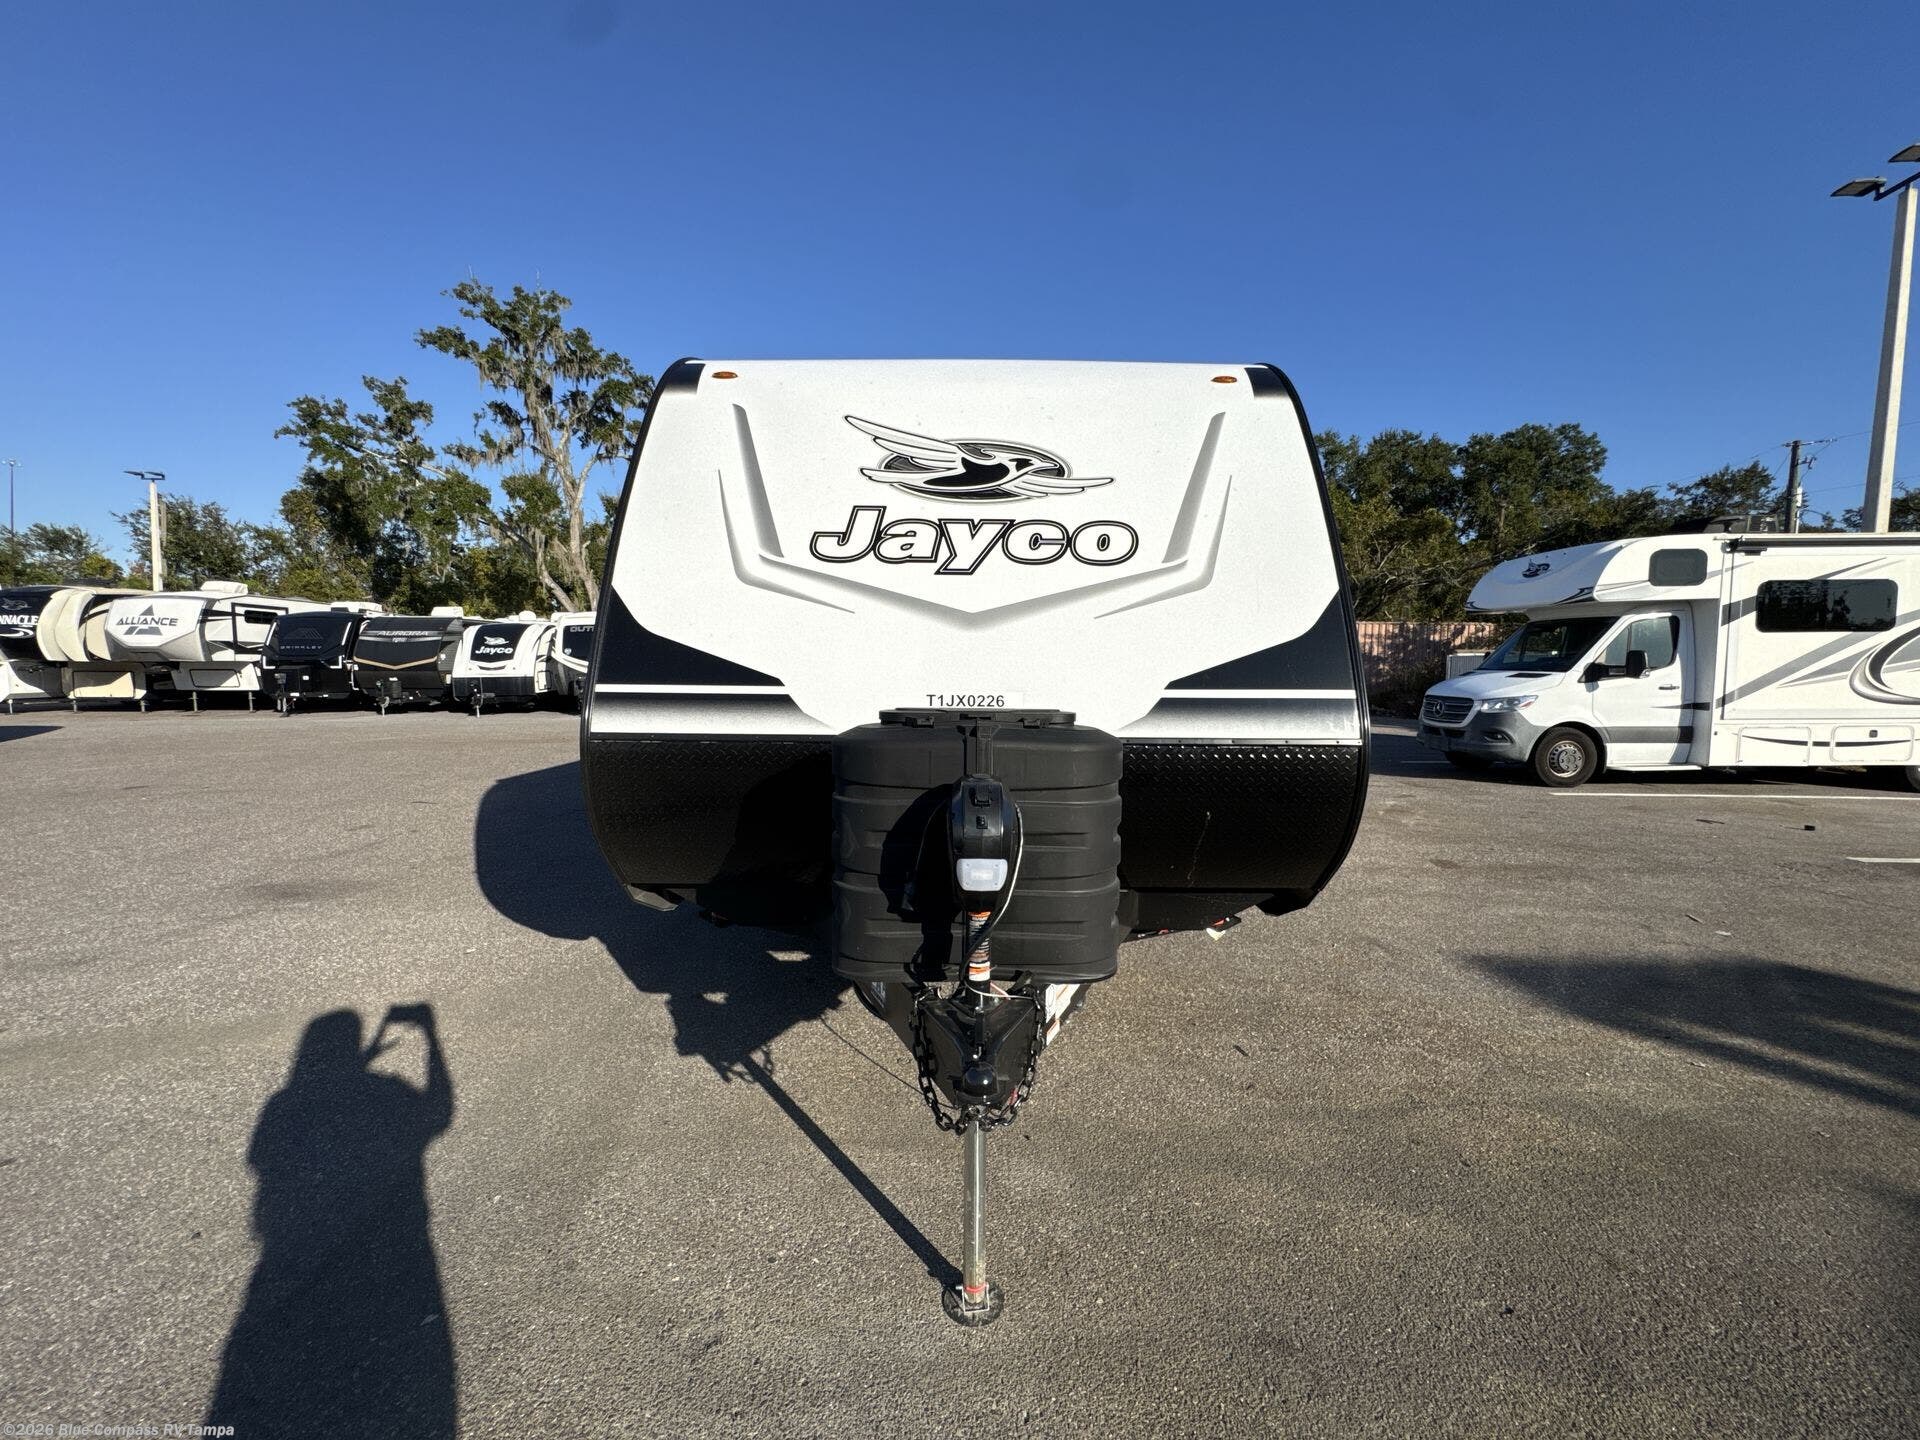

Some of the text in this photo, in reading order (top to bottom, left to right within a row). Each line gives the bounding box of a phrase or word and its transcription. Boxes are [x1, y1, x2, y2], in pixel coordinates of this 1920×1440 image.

[809, 505, 1139, 575] Jayco
[116, 616, 178, 627] ALLIANCE
[475, 646, 514, 655] Jayco
[926, 694, 1005, 707] T1JX0226
